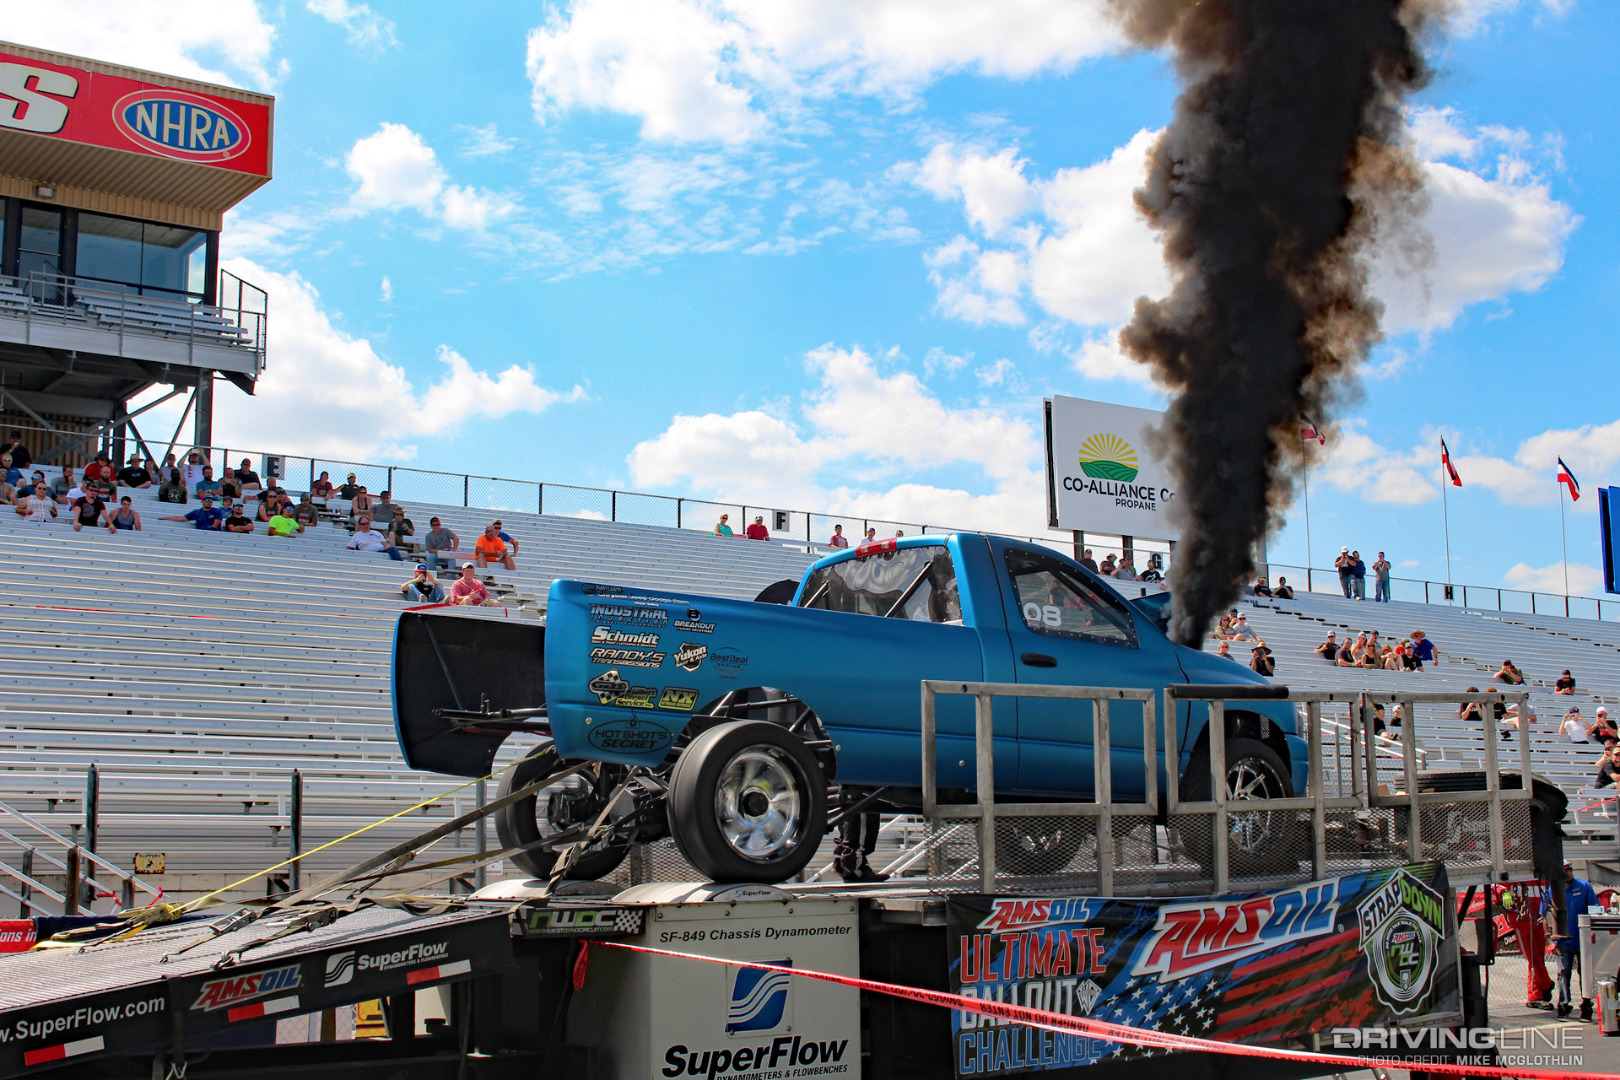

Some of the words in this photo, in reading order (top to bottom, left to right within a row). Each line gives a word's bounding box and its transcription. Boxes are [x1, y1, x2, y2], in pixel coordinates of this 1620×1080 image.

[136, 103, 231, 149] NHRA
[267, 456, 280, 478] E
[1063, 476, 1156, 501] CO-ALLIANCE
[1116, 499, 1156, 511] PROPANE
[776, 511, 787, 530] F
[1152, 554, 1161, 569] G
[1445, 586, 1454, 600] H
[1023, 602, 1061, 626] 08
[591, 625, 660, 645] Schmidt
[674, 620, 716, 630] BREAKOUT
[590, 647, 665, 662] RANDY'S
[673, 646, 707, 663] Yukon
[663, 690, 695, 703] NX
[601, 738, 658, 749] SECRET
[977, 899, 1091, 933] AMSOIL
[1363, 879, 1401, 937] STRAP
[1400, 879, 1442, 930] DOWN
[659, 930, 706, 943] SF-849
[709, 927, 761, 941] Chassis
[765, 924, 852, 939] Dynamometer
[1131, 878, 1341, 983] AMSOIL
[358, 942, 447, 971] SuperFlow
[960, 928, 1106, 983] ULTIMATE
[191, 964, 302, 1011] AMSOIL
[662, 1035, 849, 1080] SuperFlow
[959, 1026, 1102, 1074] CHALLENGE
[793, 1064, 848, 1077] FLOWBENCHES
